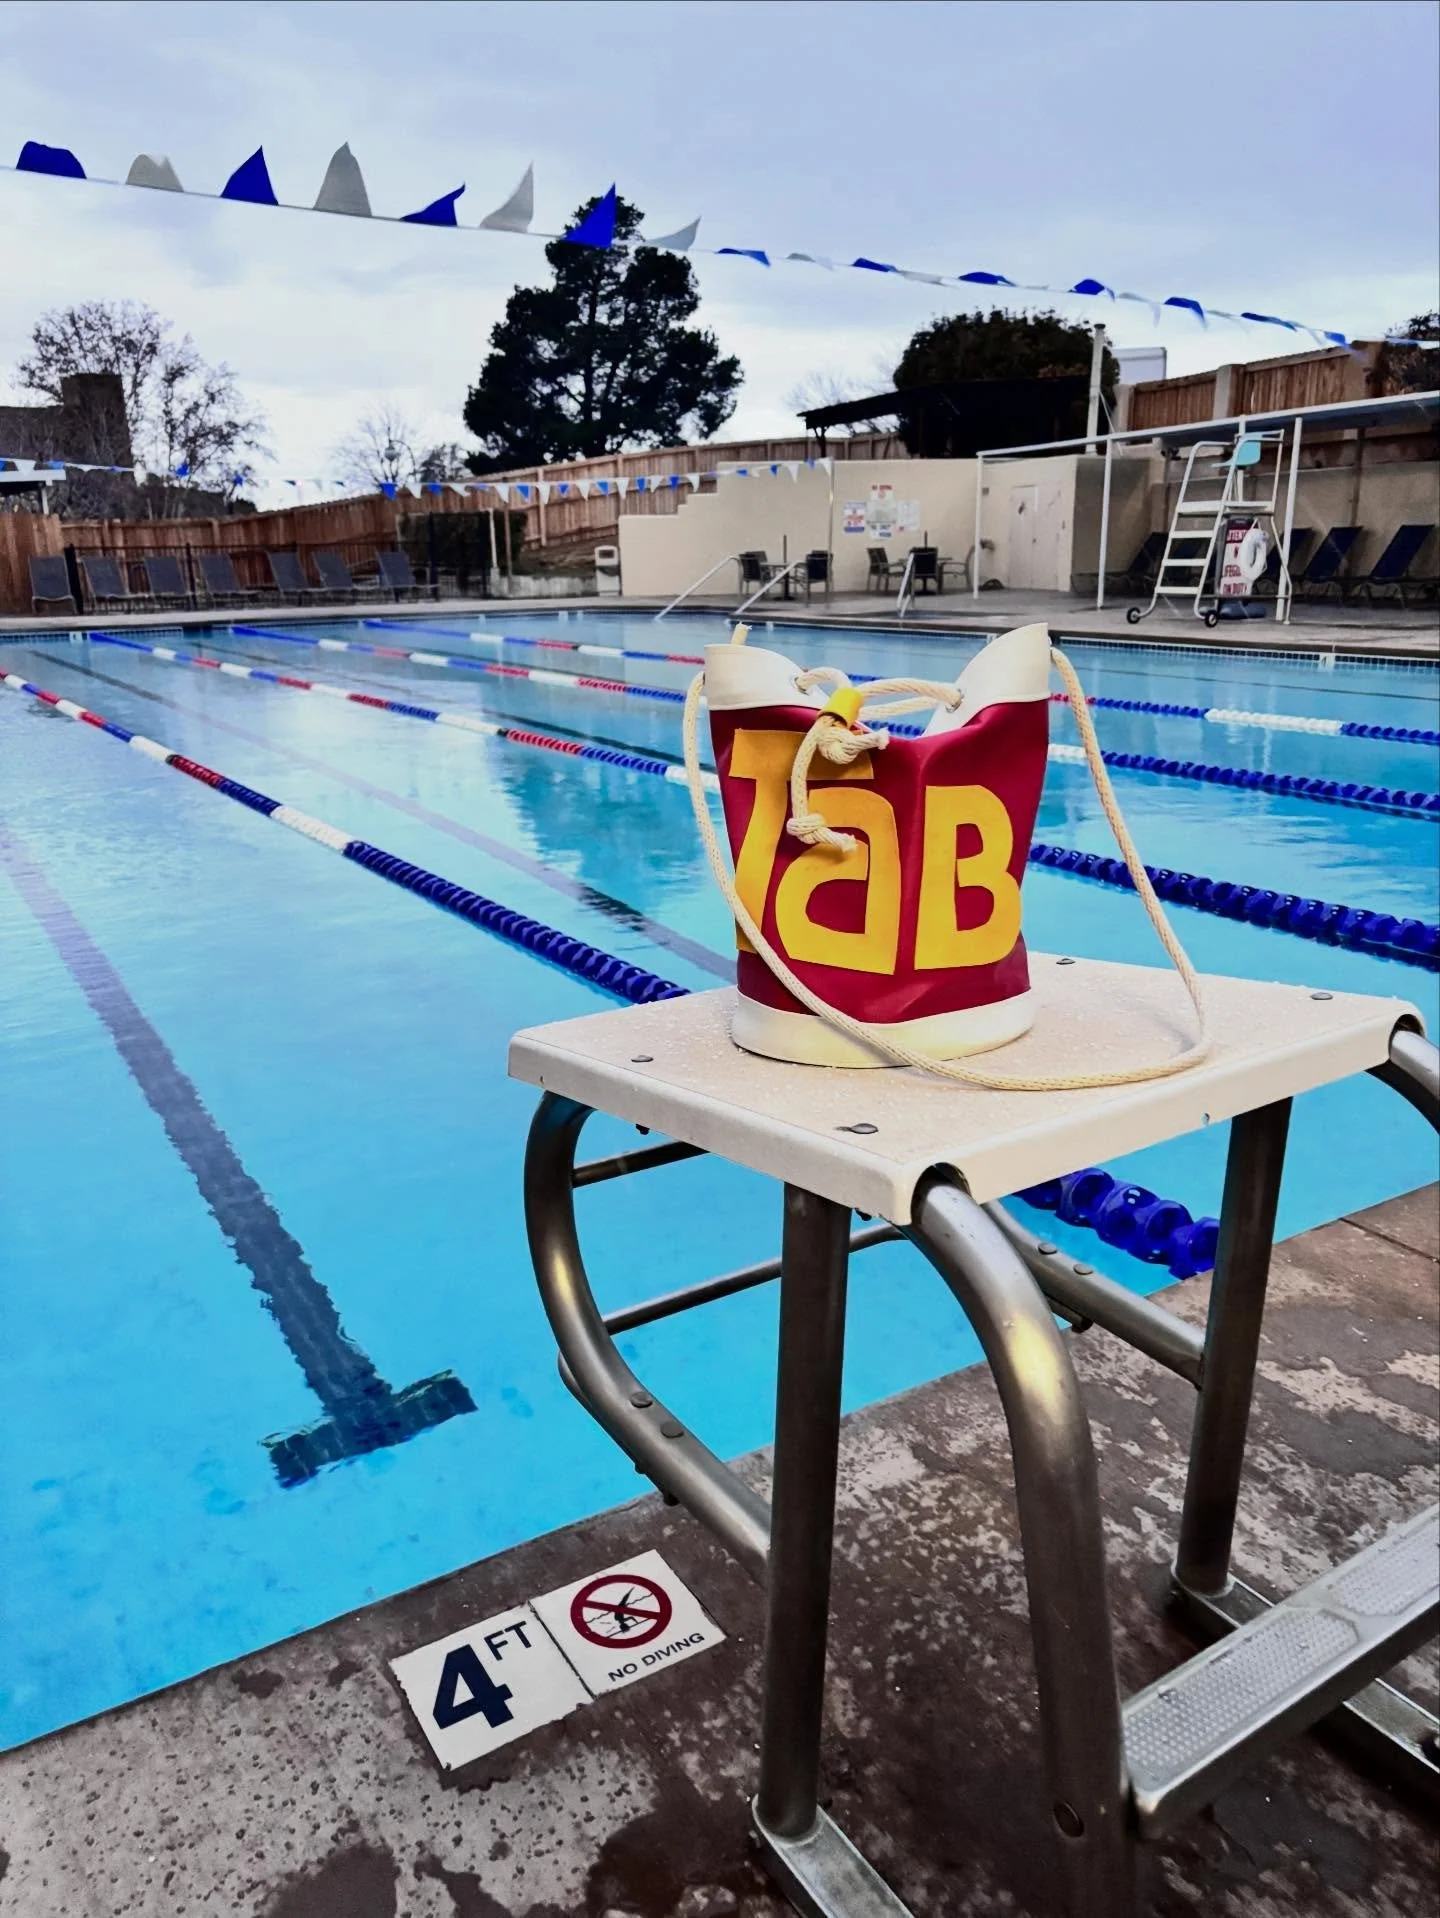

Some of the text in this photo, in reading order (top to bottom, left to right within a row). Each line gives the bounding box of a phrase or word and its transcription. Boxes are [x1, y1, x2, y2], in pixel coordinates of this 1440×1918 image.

[433, 1621, 532, 1729] 4 FT
[608, 1632, 705, 1682] NO DIVING
